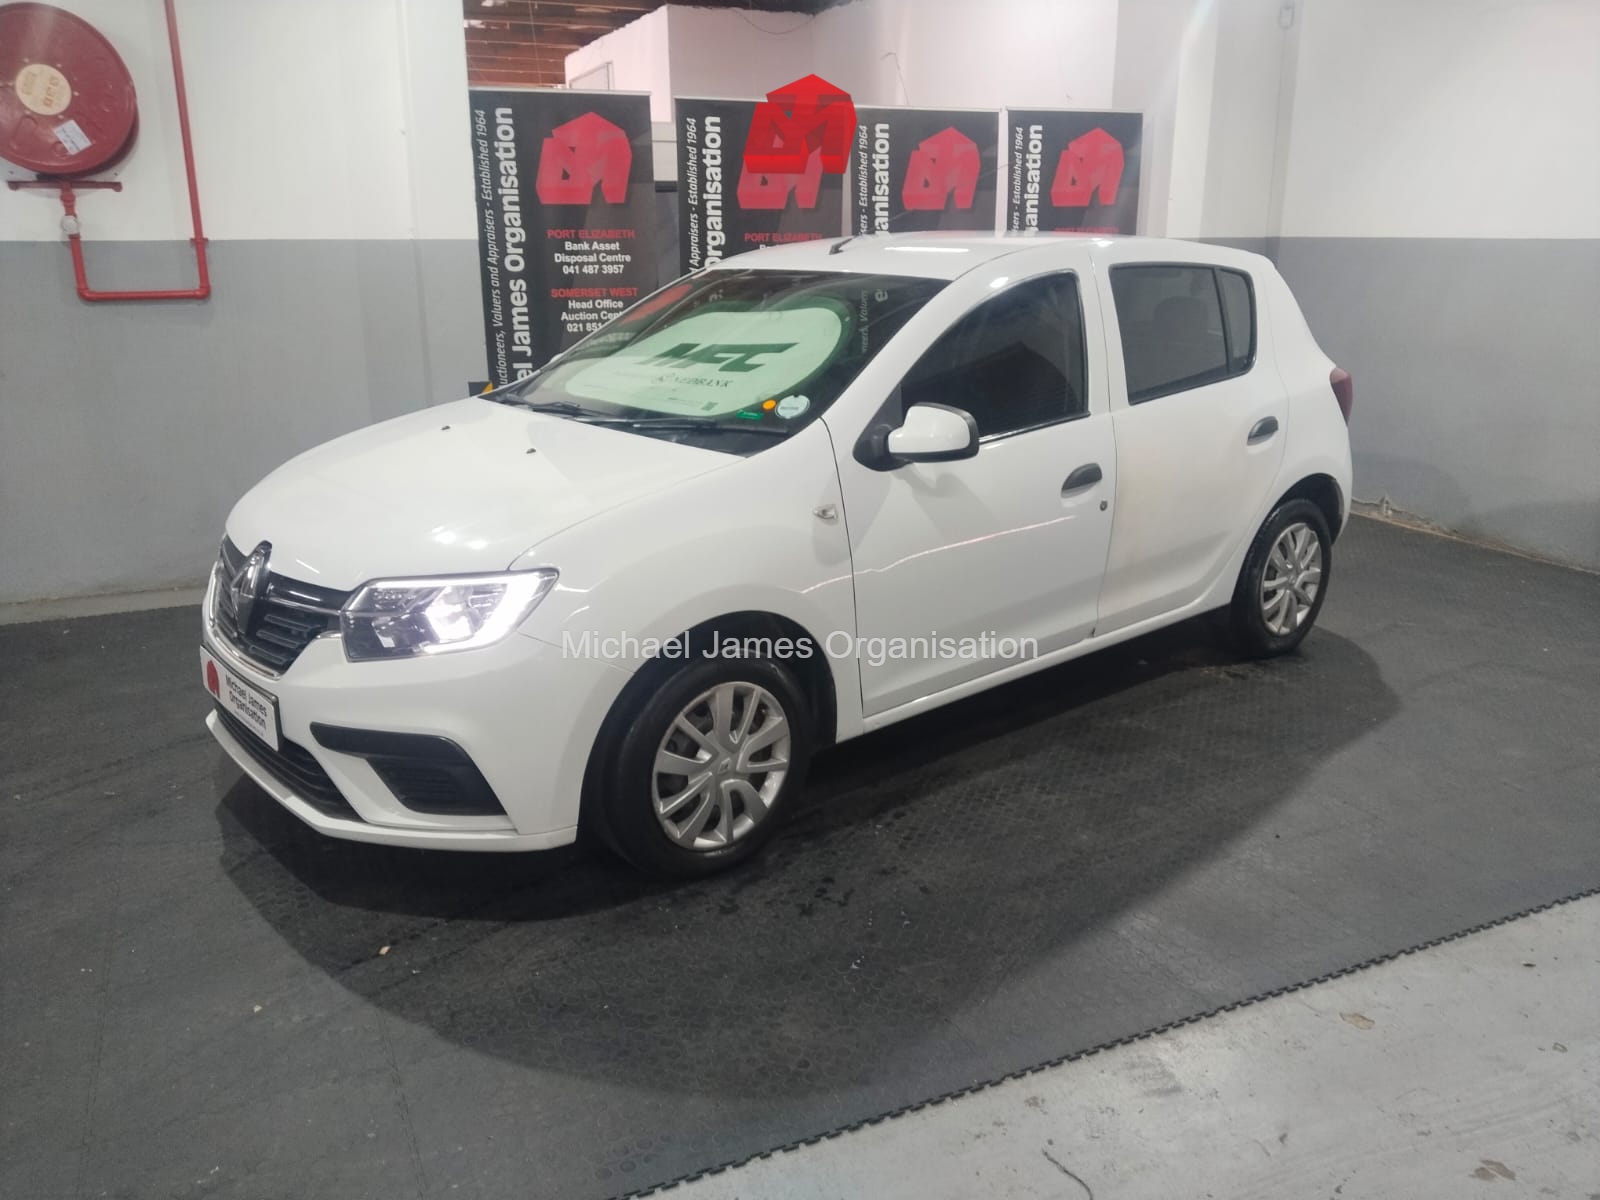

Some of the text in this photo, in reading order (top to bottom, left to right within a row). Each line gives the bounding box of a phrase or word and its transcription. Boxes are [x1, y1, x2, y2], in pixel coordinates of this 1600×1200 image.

[475, 109, 487, 136] 1964
[686, 117, 697, 143] 1964
[858, 125, 868, 149] 1964
[1014, 126, 1023, 149] 1964
[476, 139, 493, 200] Established
[686, 146, 698, 205] Established
[858, 151, 868, 207] Established
[872, 123, 889, 235] anisation
[1012, 151, 1023, 204] Established
[1024, 124, 1043, 231] anisation
[493, 107, 526, 273] Organisation
[484, 209, 500, 267] Appraisers
[546, 229, 635, 239] PORT ELIZABETH
[564, 241, 620, 251] Bank Asset
[688, 213, 701, 267] Appraisers
[744, 232, 769, 242] PORT
[554, 253, 631, 264] Disposal Centre
[562, 264, 625, 274] 041 487 3957
[488, 268, 500, 288] and
[551, 287, 639, 298] SOMERSET WEST
[568, 299, 624, 309] Head Office
[491, 289, 503, 327] Valuers
[509, 278, 533, 357] James
[561, 312, 598, 321] Auction
[567, 323, 583, 332] 021
[494, 330, 508, 387] uctioneers,
[229, 689, 267, 730] Organisation
[248, 692, 267, 718] James
